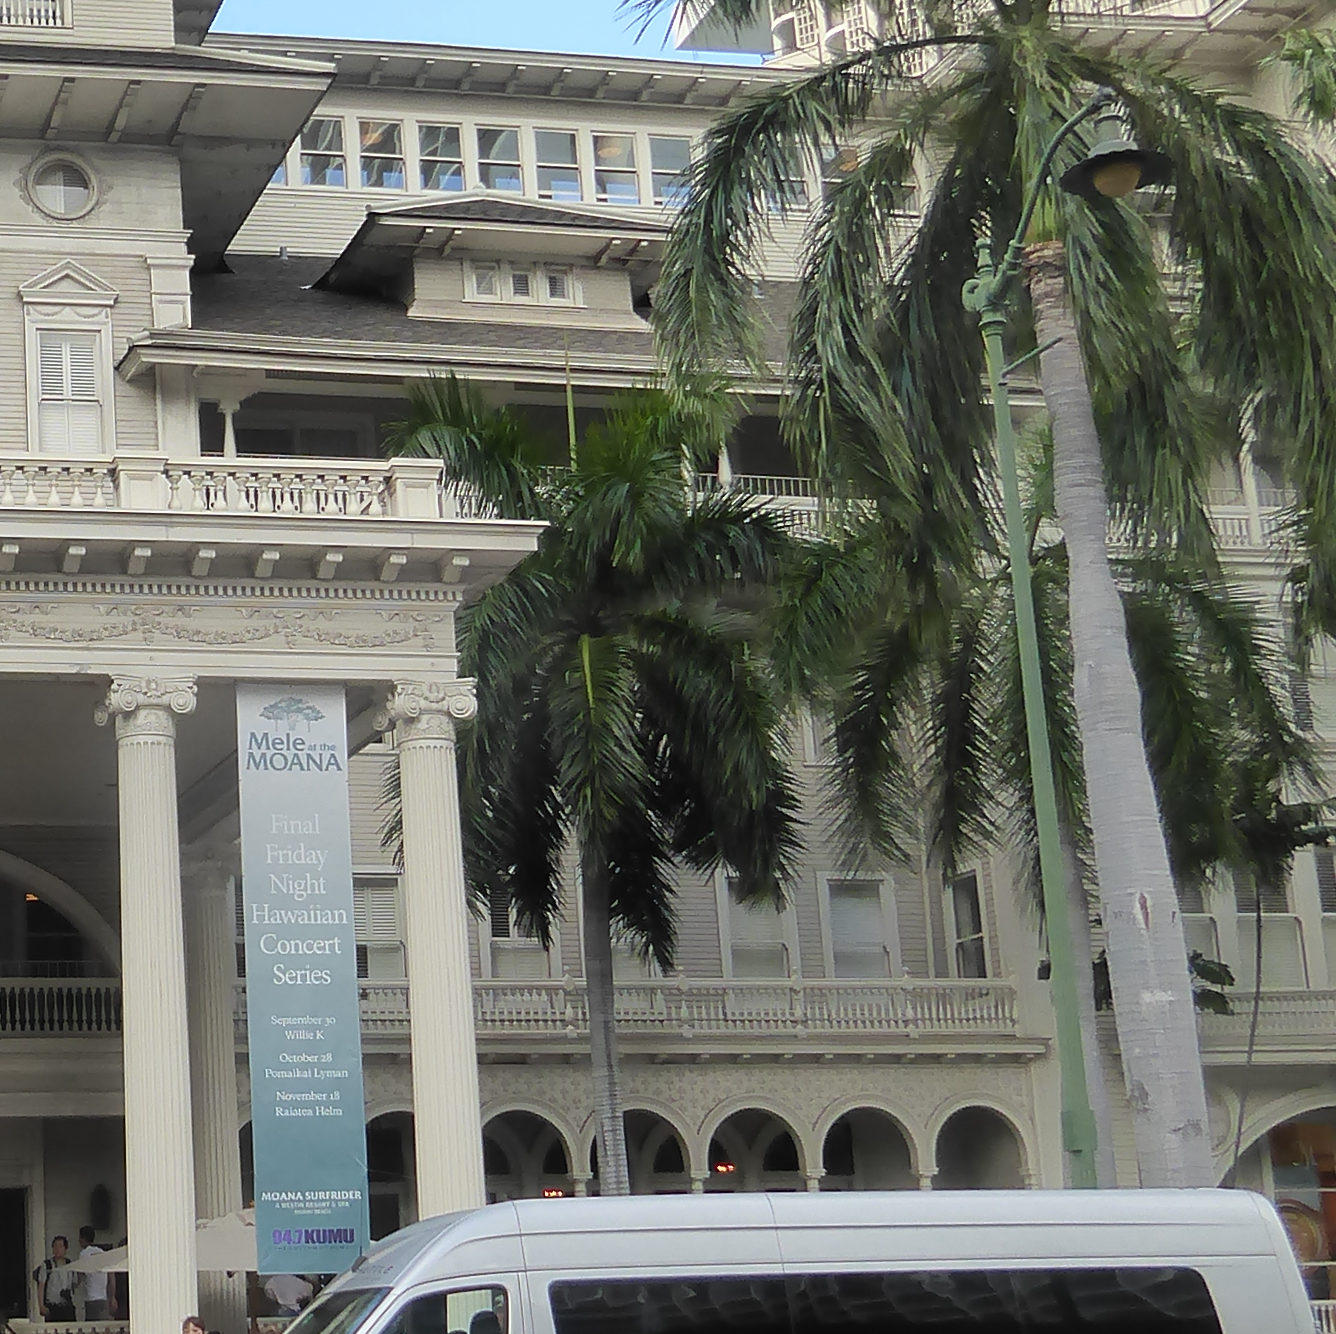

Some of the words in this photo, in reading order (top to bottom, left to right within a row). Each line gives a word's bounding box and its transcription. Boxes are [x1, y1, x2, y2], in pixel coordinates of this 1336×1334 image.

[248, 732, 305, 751] Mele
[320, 743, 337, 751] the
[246, 752, 343, 771] MOANA
[270, 813, 320, 835] Final
[265, 843, 328, 870] Friday
[269, 873, 327, 901] Night
[251, 904, 348, 924] Hawaiian
[259, 933, 342, 954] Concert
[273, 964, 331, 985] Series
[270, 1015, 323, 1027] September
[325, 1017, 336, 1027] 30
[285, 1030, 314, 1040] Willie
[316, 1030, 325, 1040] K
[279, 1053, 318, 1063] October
[320, 1053, 333, 1062] 28
[314, 1068, 348, 1080] Lyman
[276, 1091, 327, 1101] November
[329, 1091, 340, 1101] 18
[316, 1106, 343, 1116] Helm
[261, 1191, 303, 1201] MOANA
[305, 1190, 362, 1200] SURFRIDER
